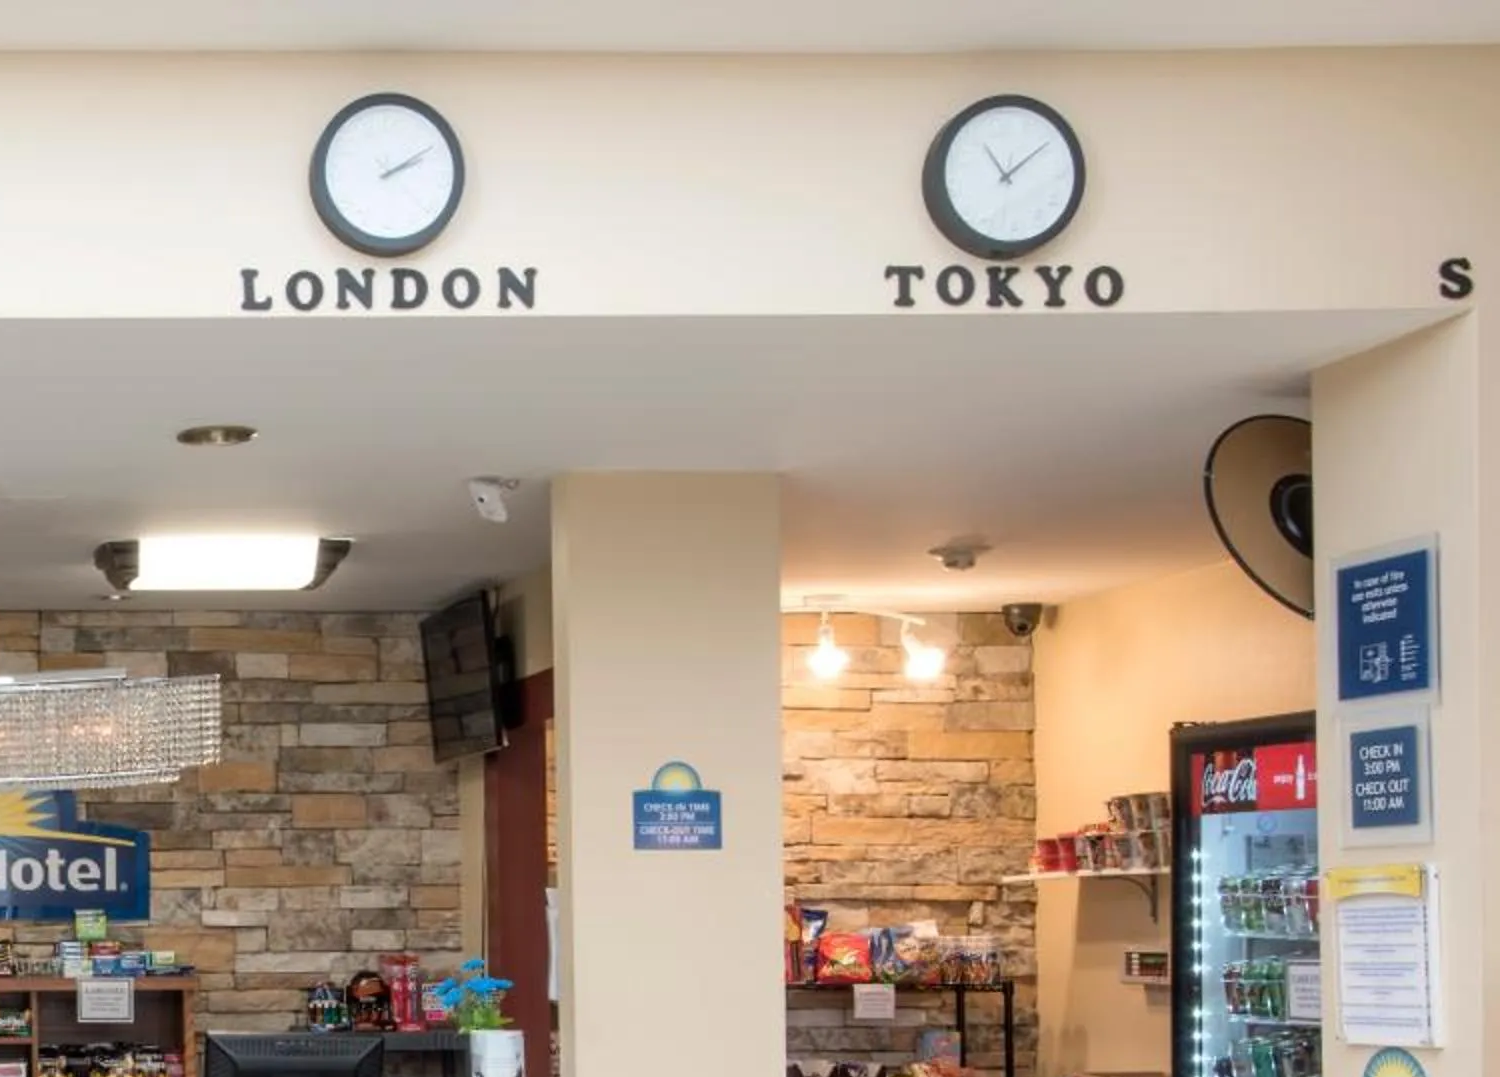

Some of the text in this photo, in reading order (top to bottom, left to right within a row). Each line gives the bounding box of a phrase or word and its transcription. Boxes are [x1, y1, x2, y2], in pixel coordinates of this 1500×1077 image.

[241, 268, 537, 311] LONDON
[884, 265, 1125, 308] TOKYO
[1359, 741, 1404, 760] CHECK IN
[1386, 759, 1401, 774] PM
[1355, 778, 1410, 797] CHECK OUT
[1388, 795, 1405, 810] AM
